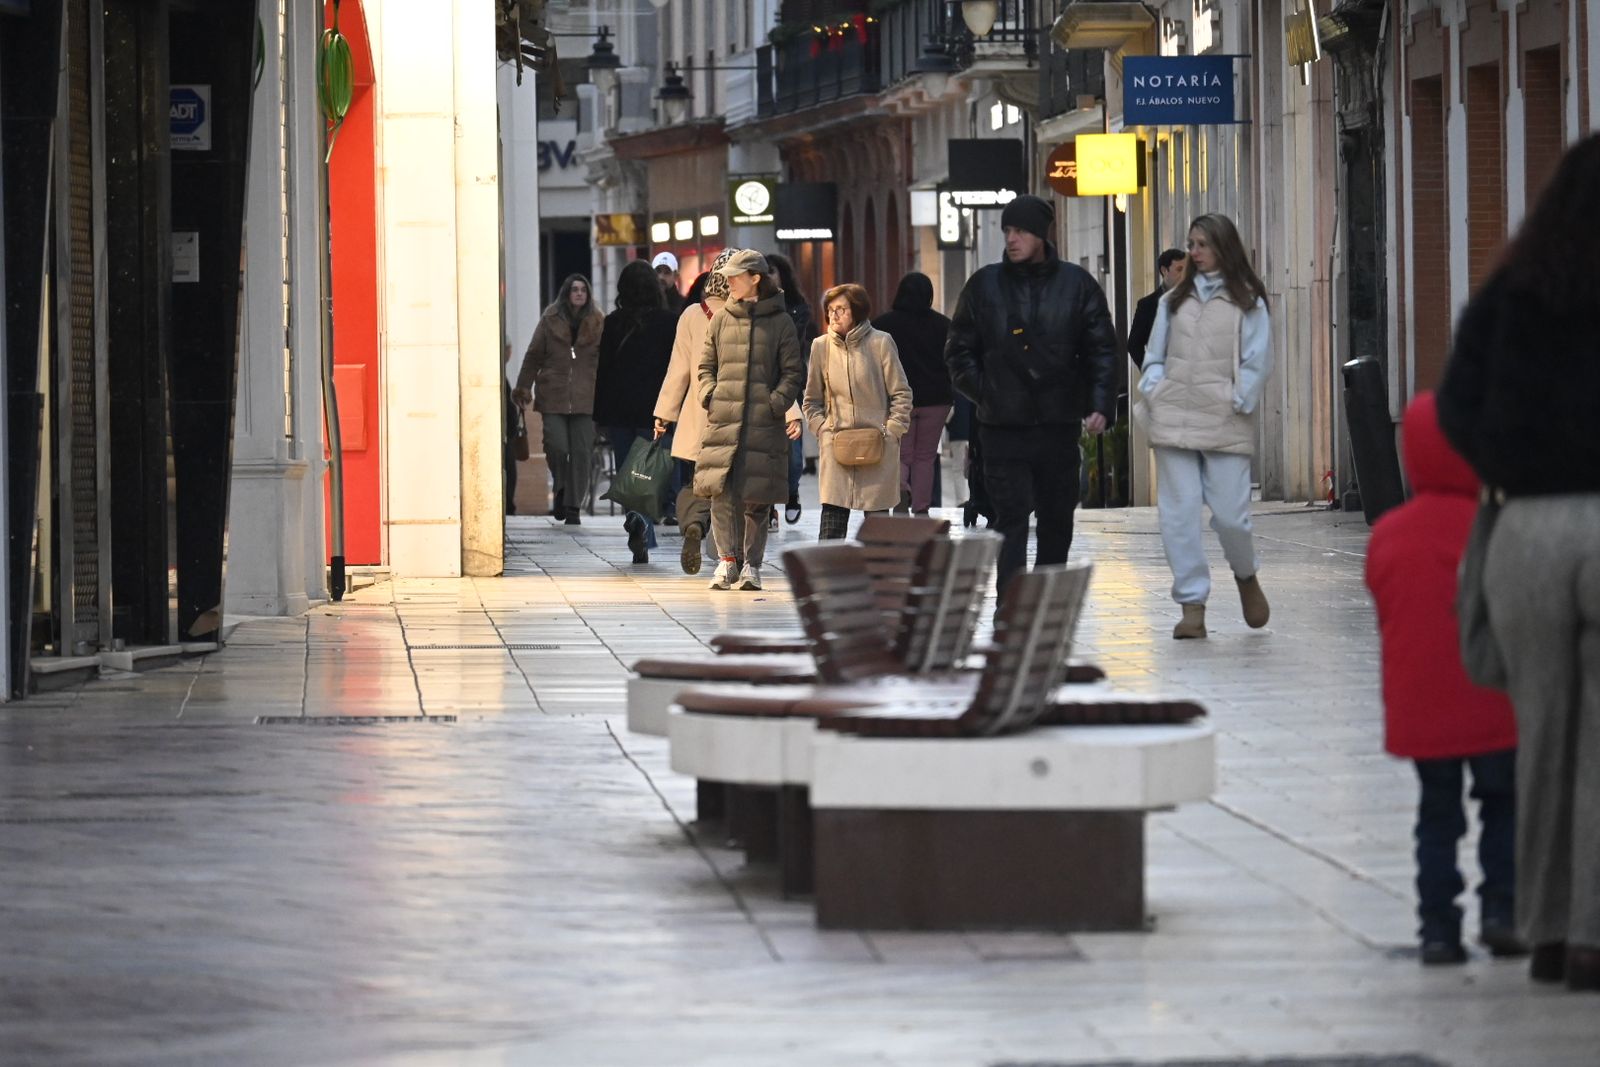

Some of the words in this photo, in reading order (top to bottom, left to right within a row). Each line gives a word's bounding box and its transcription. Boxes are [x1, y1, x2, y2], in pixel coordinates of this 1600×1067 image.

[1133, 72, 1221, 88] NOTARÍA
[1149, 96, 1183, 106] ÁBALOS
[1187, 96, 1221, 105] NUEVO
[170, 103, 197, 119] ADT
